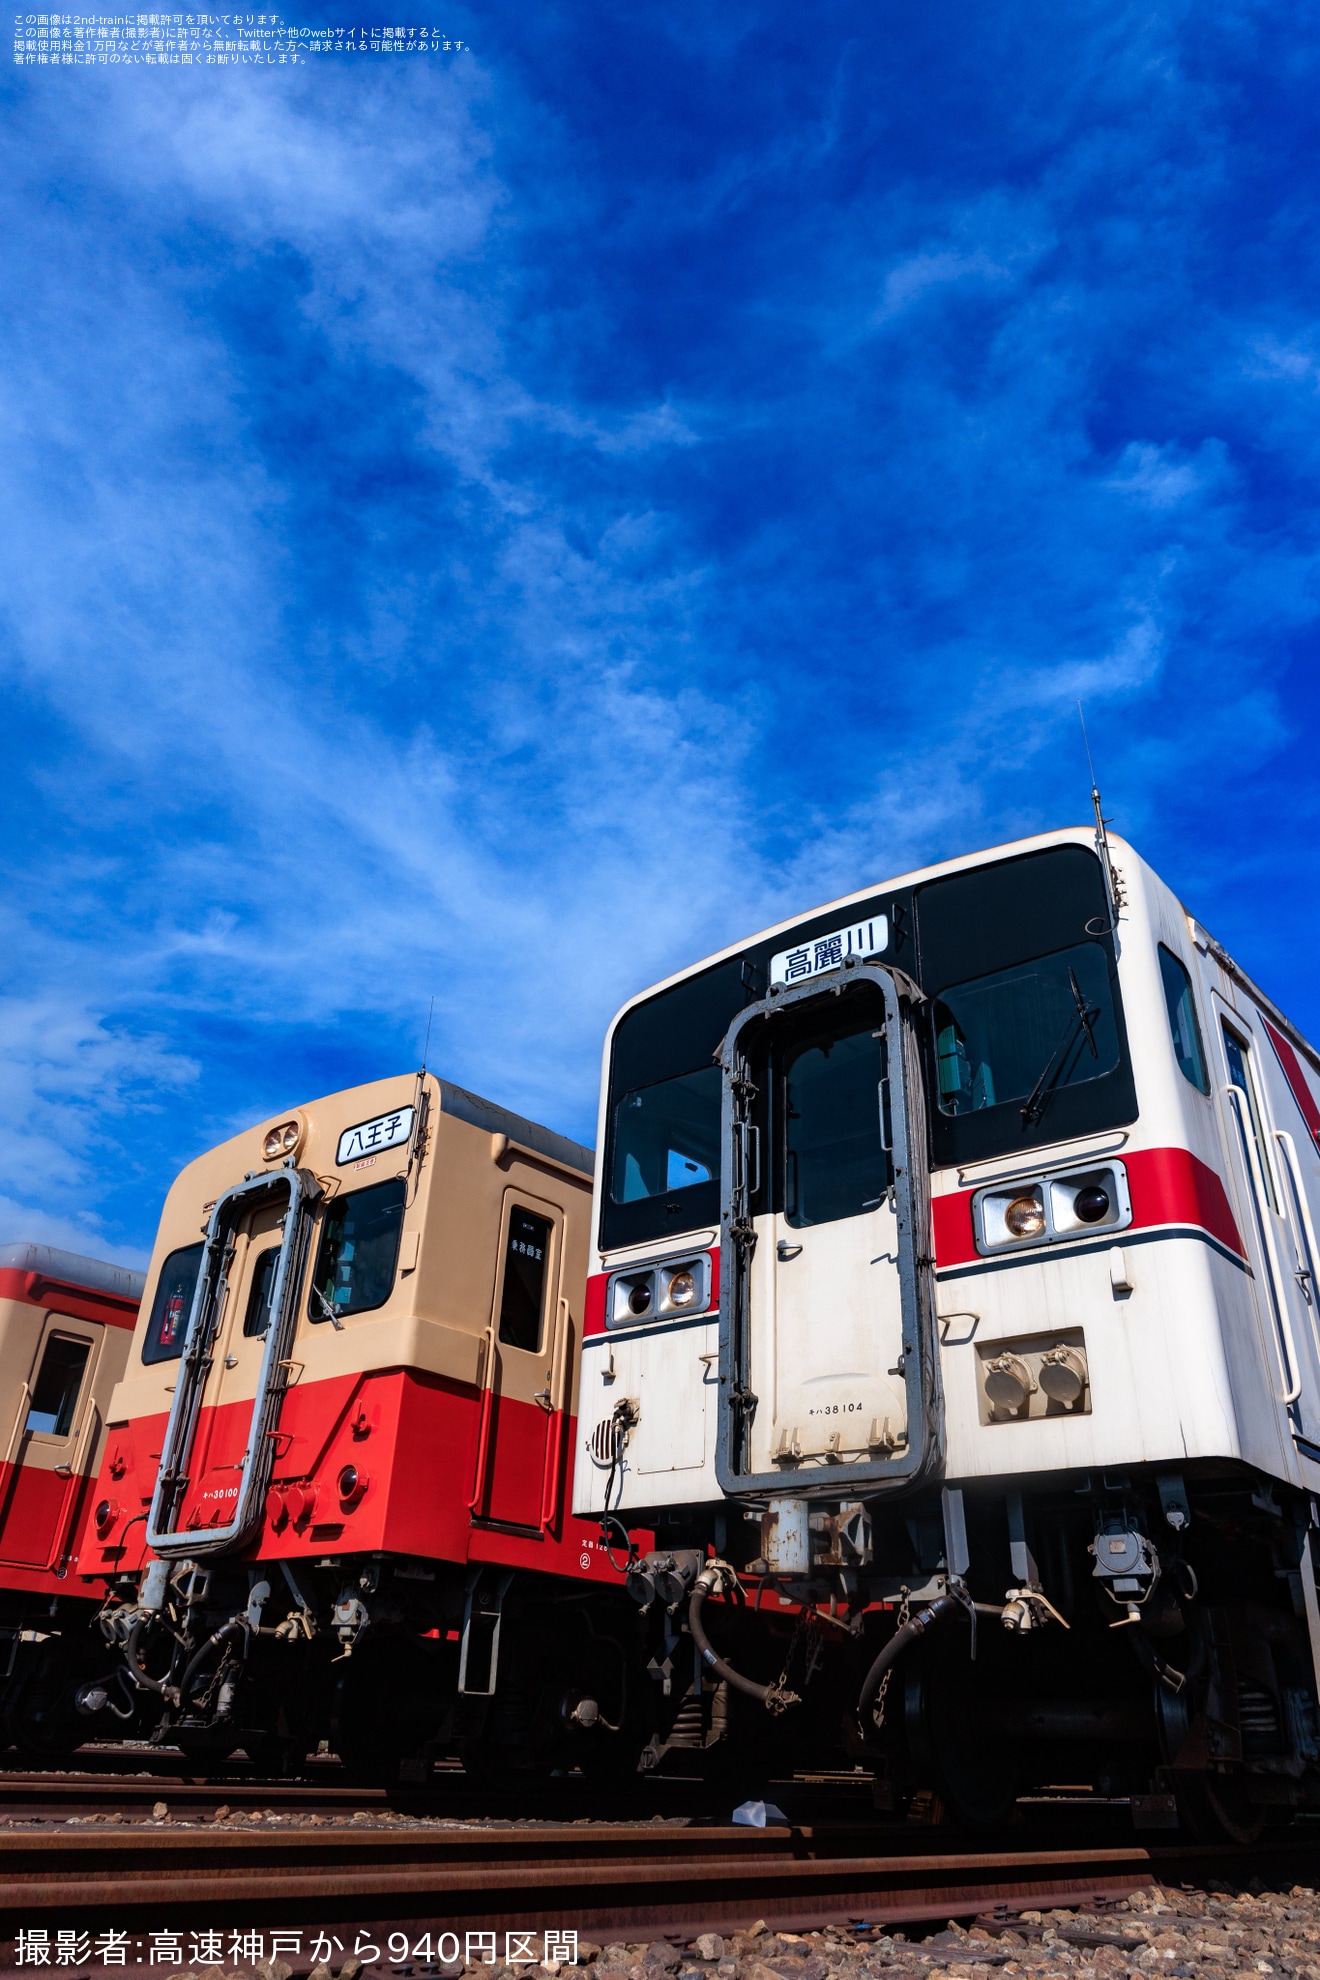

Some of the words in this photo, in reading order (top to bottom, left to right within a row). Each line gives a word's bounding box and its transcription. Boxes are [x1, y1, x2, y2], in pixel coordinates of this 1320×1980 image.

[785, 922, 874, 982] 高麗川
[346, 1115, 402, 1157] 八王子
[809, 1402, 863, 1416] キハ38104
[203, 1487, 238, 1500] キハ30100
